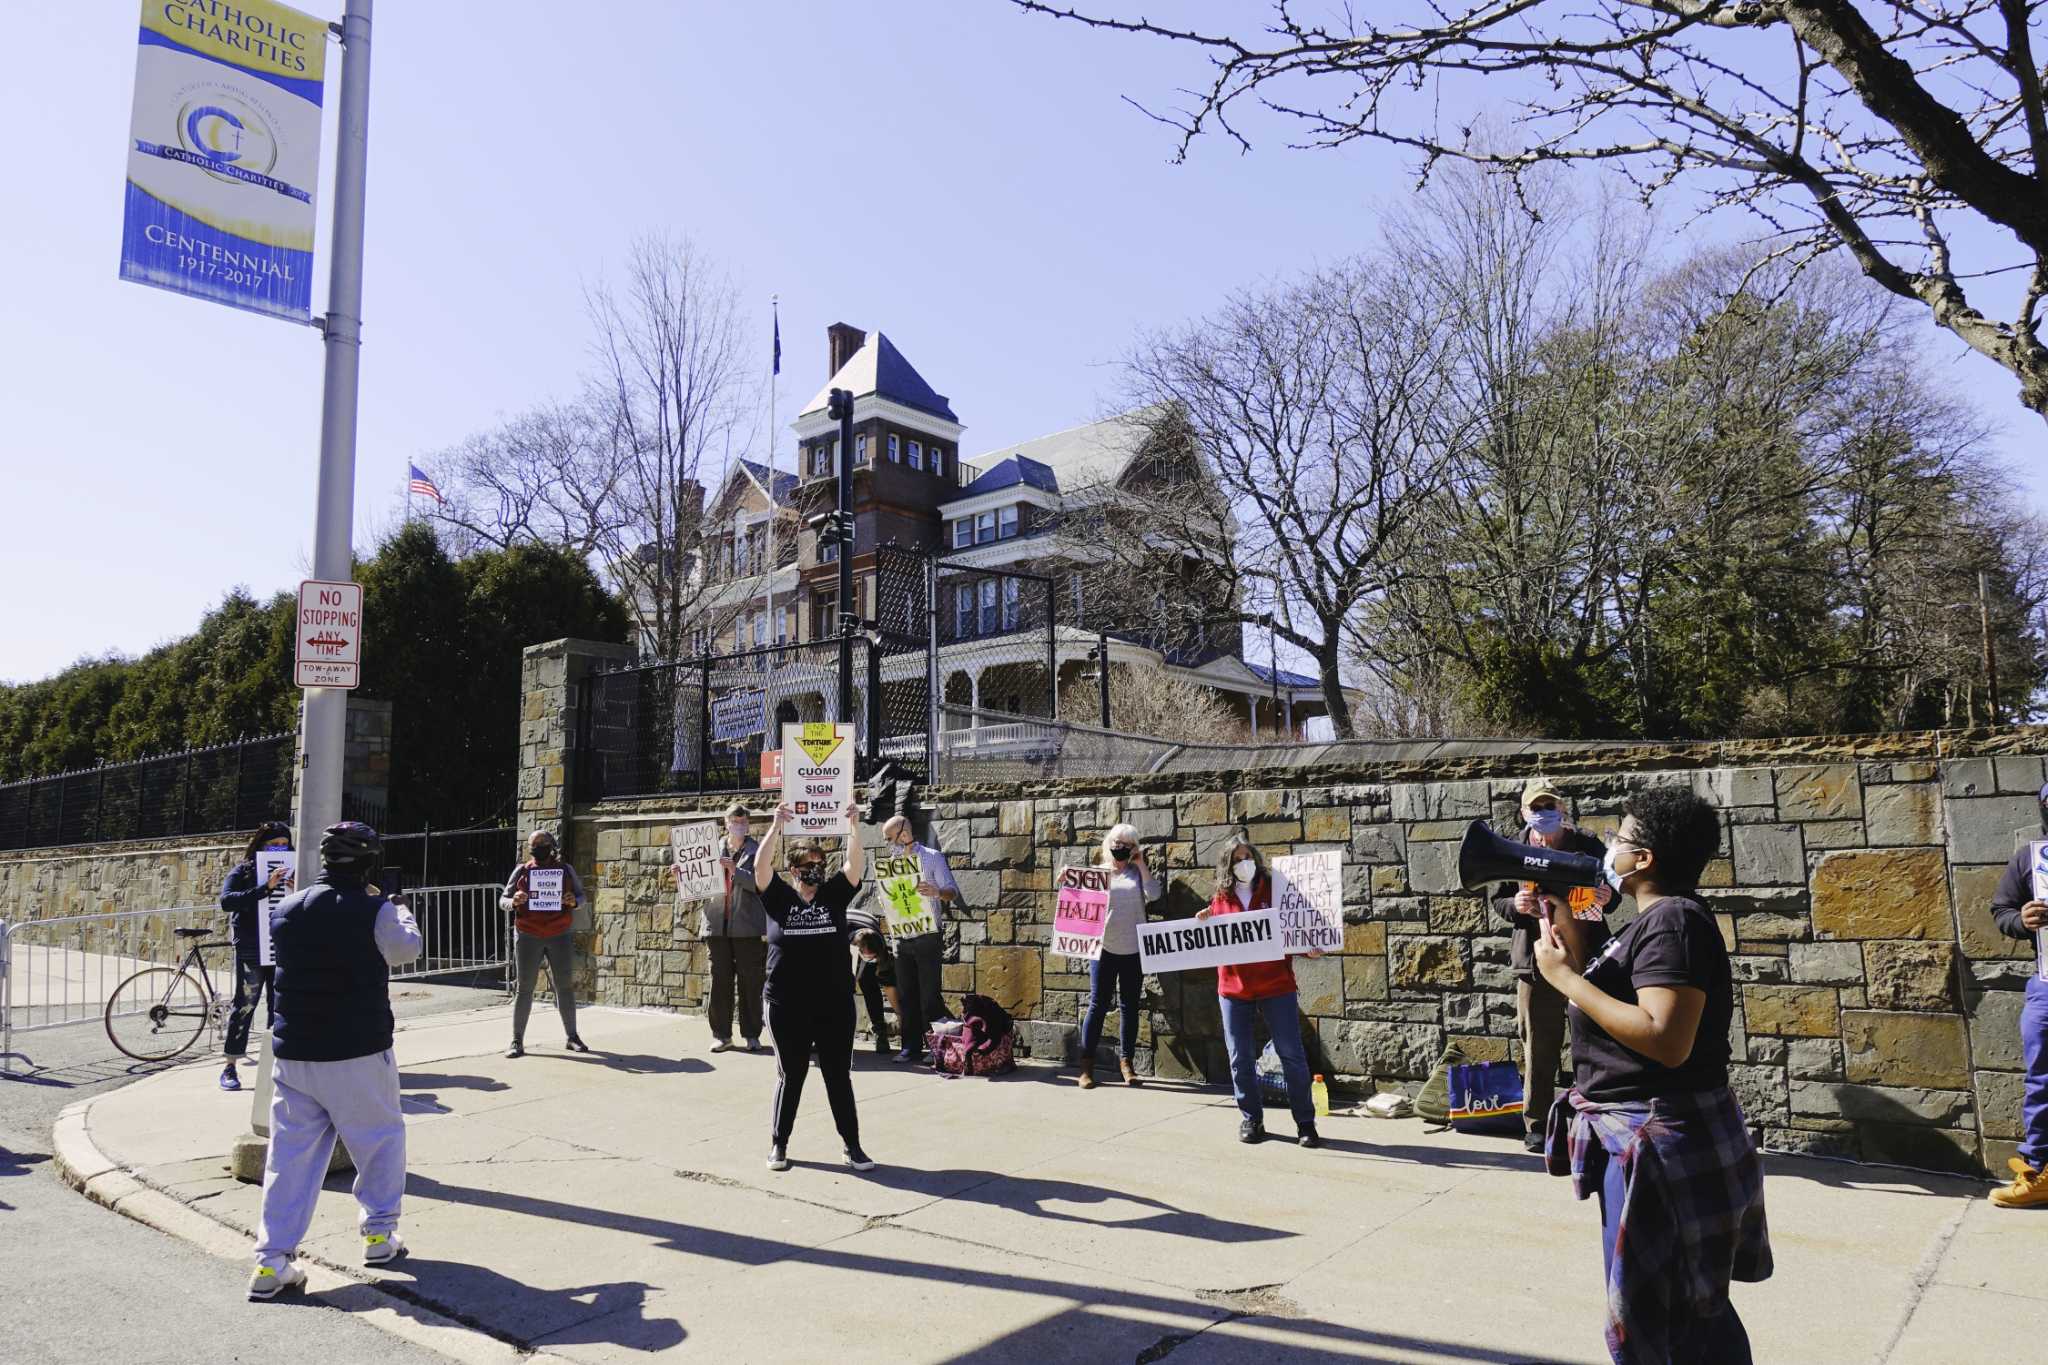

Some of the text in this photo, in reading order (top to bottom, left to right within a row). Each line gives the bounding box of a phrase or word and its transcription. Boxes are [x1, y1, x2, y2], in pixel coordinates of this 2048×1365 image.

[175, 0, 305, 50] ATHOLIC
[165, 4, 306, 71] CHARITIES
[164, 149, 224, 171] CATHOLIC
[226, 166, 285, 191] CHARITIES
[145, 224, 295, 280] CENTENNIAL
[178, 255, 263, 288] 1917-2017
[319, 590, 342, 606] NO
[303, 609, 357, 627] STOPPING
[318, 631, 340, 640] ANY
[316, 645, 341, 656] TIME
[304, 664, 351, 673] TOW-AWAY
[314, 675, 340, 683] ZONE
[797, 767, 840, 776] CUOMO
[805, 784, 833, 795] SIGN
[810, 801, 840, 810] HALT
[800, 817, 837, 826] NOW!!!
[674, 825, 713, 847] CUOMO
[679, 844, 710, 863] SIGN
[1524, 856, 1550, 867] PYLE
[679, 859, 716, 882] HALT
[875, 854, 920, 878] SIGN
[1064, 868, 1109, 891] SIGN
[1286, 872, 1330, 892] AREA
[1280, 889, 1332, 910] AGAINST
[1058, 900, 1105, 921] HALT
[1280, 909, 1337, 929] SOLITARY
[892, 916, 931, 936] NOW!
[1057, 935, 1101, 955] NOW!
[1142, 918, 1273, 957] HALTSOLITARY!
[1464, 1088, 1505, 1115] love
